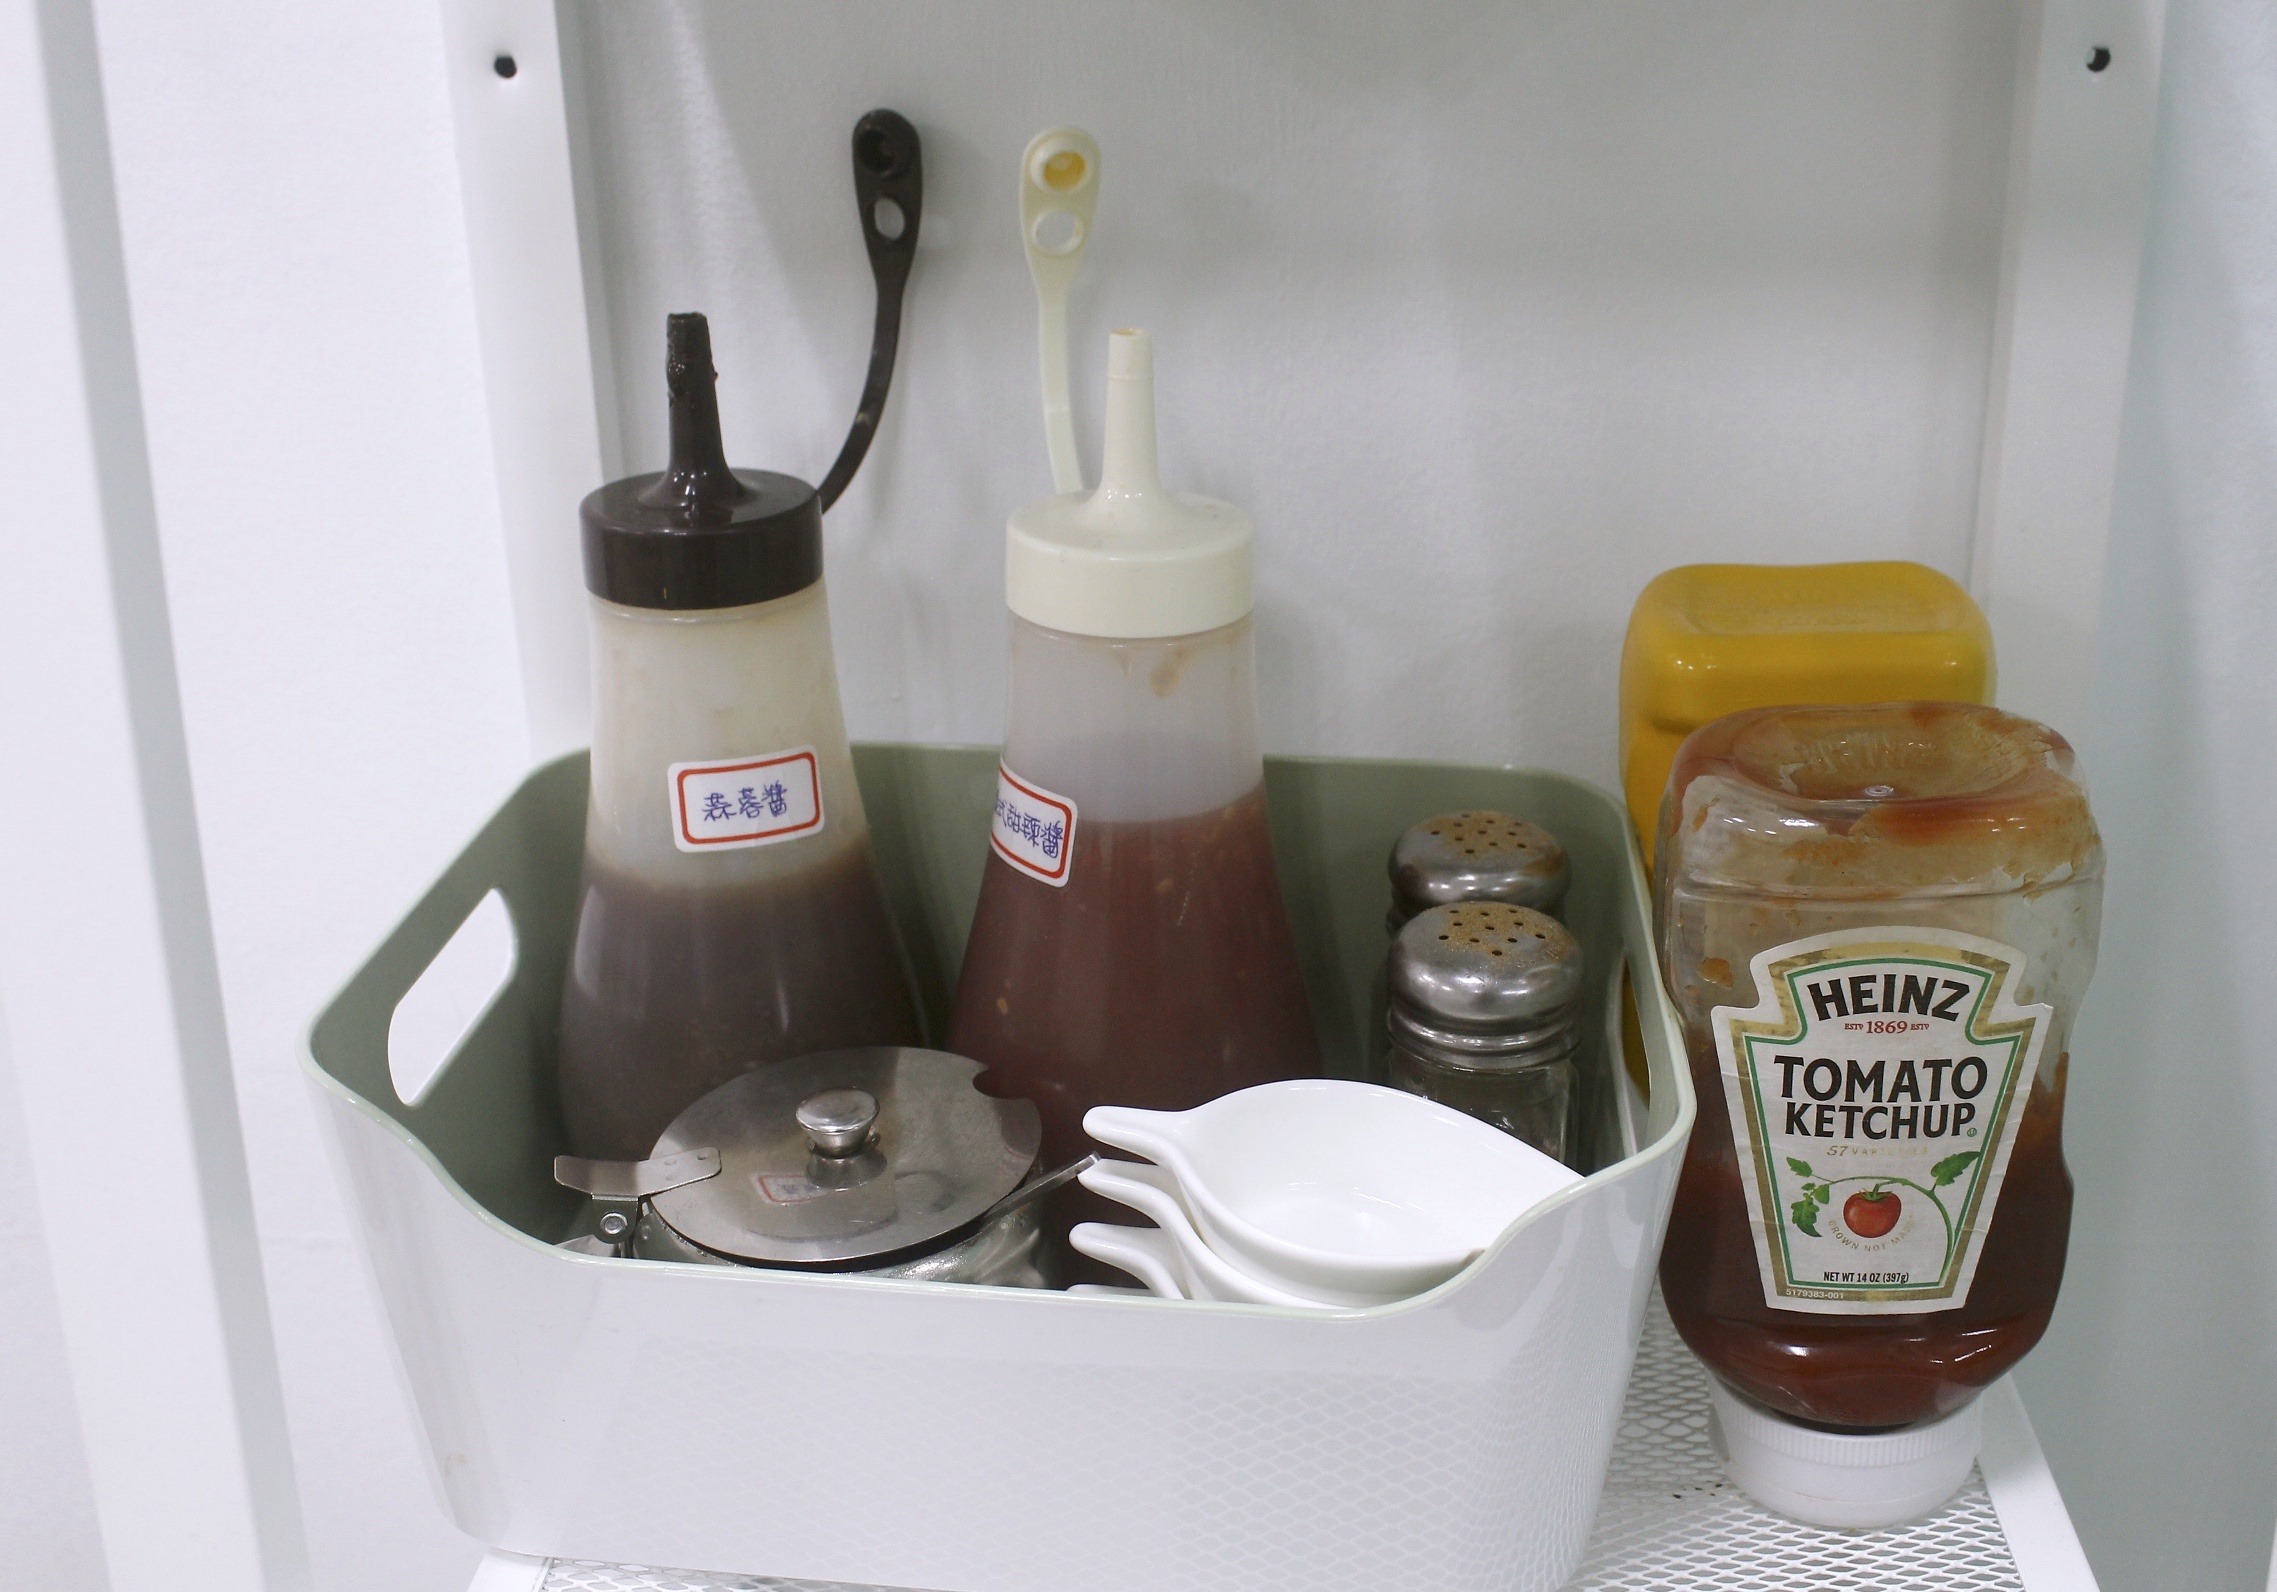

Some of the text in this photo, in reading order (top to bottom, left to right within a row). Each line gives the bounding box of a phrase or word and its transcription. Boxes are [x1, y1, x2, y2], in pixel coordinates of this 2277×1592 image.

[1807, 974, 1970, 1021] HEINZ
[1866, 1020, 1908, 1034] 1869
[1773, 1055, 1988, 1103] TOMATO
[1785, 1101, 1977, 1139] KETCHUP
[1827, 1145, 1849, 1157] 57
[1828, 1219, 1860, 1250] GROWN
[1823, 1272, 1909, 1285] NET WT 14 OZ (397g)
[1786, 1289, 1844, 1300] 5179383-001
